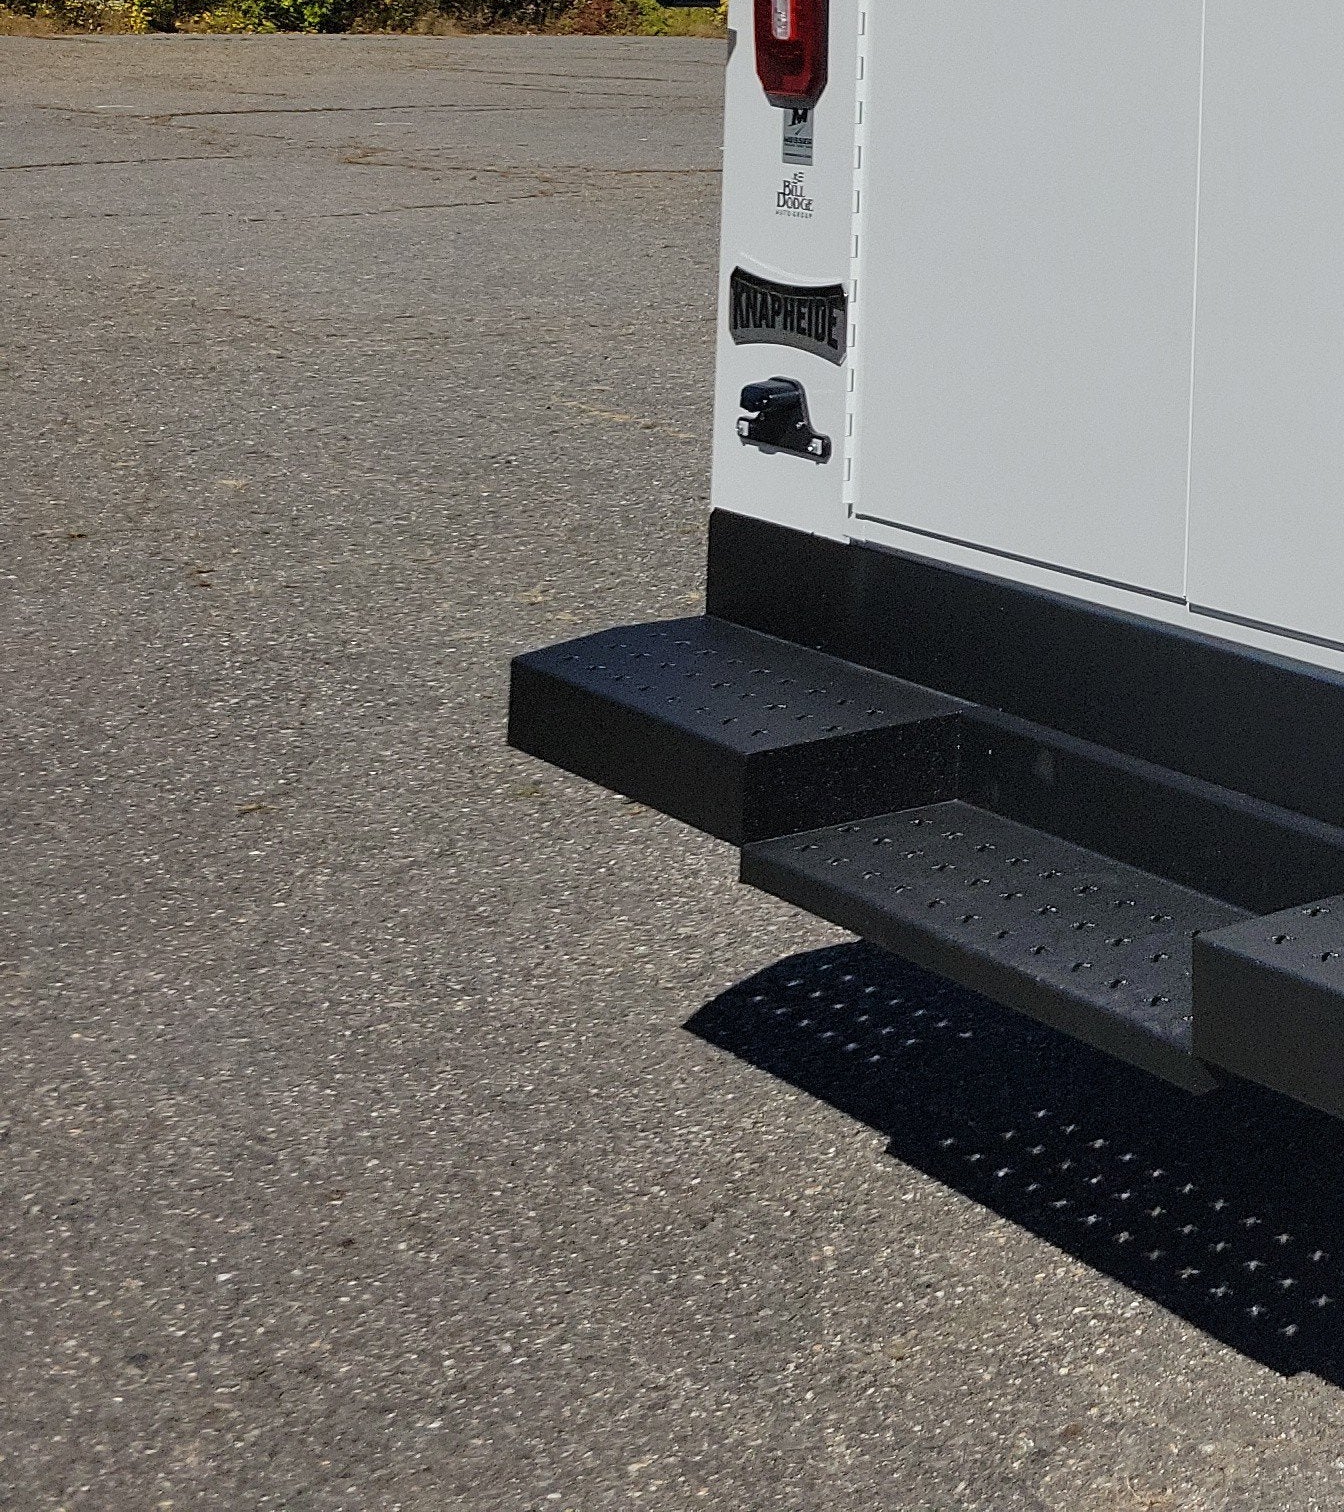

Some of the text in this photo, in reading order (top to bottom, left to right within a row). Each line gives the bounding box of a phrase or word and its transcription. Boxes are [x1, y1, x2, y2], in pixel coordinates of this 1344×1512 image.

[783, 180, 806, 197] BILL
[777, 192, 813, 211] DODGE
[732, 280, 843, 350] KNAPHEIDE
